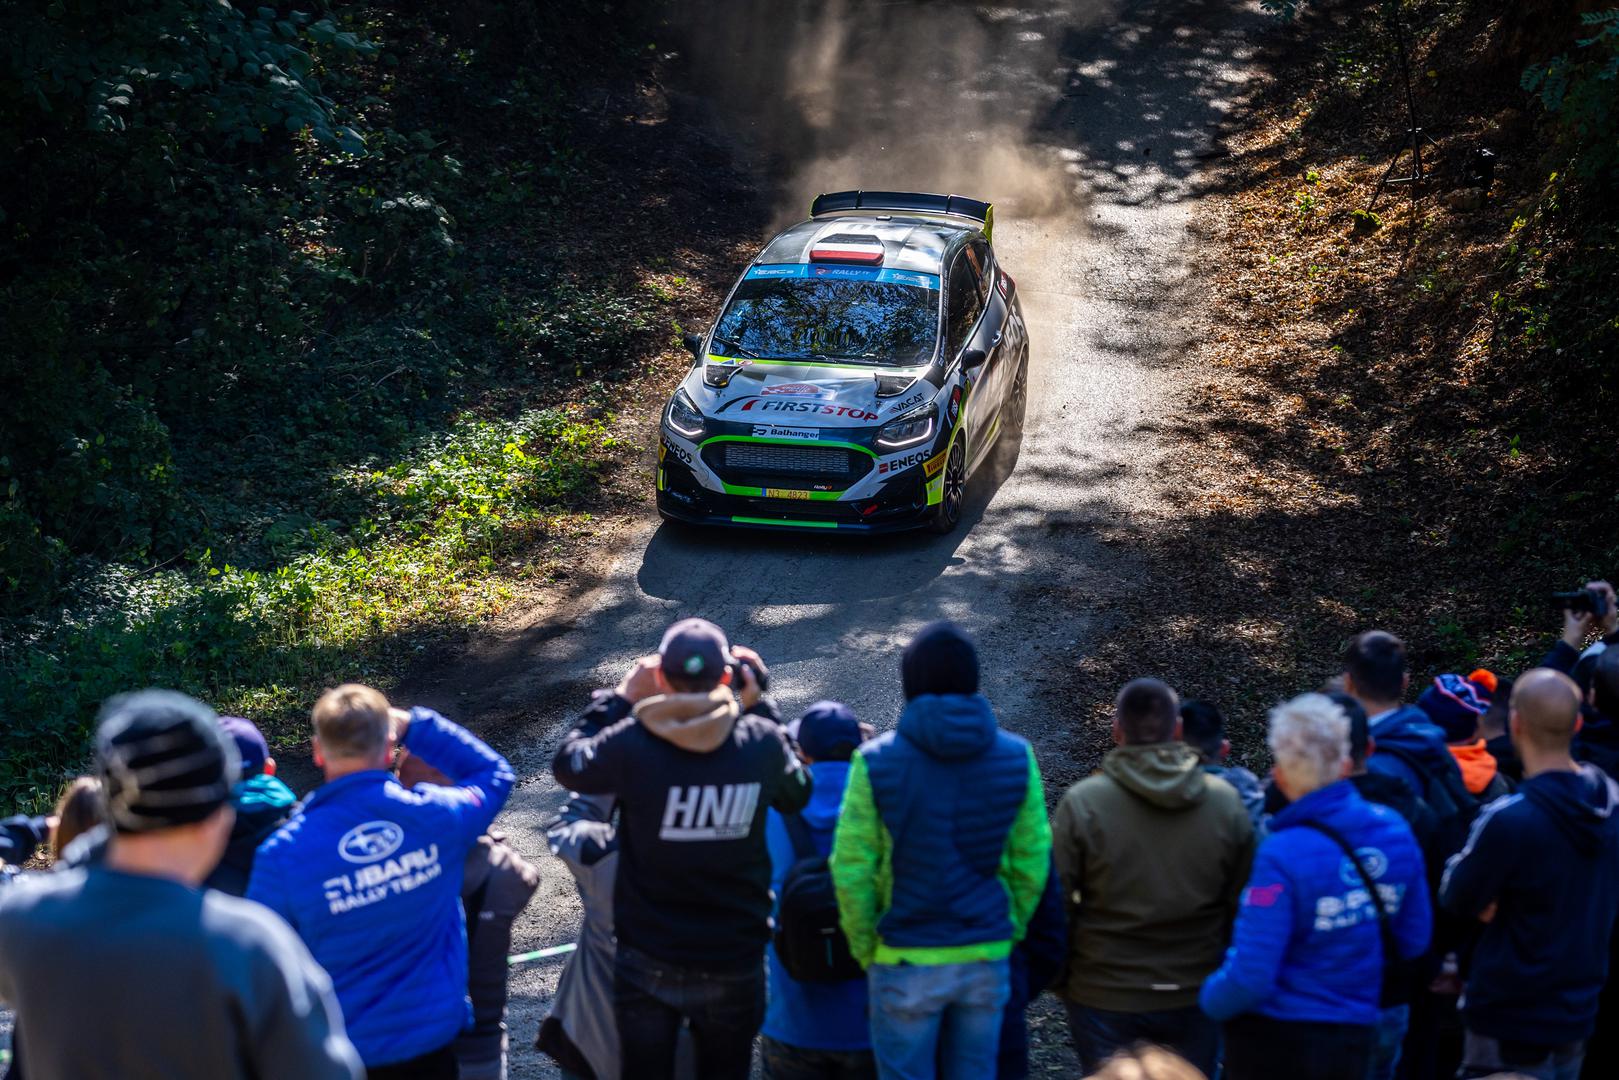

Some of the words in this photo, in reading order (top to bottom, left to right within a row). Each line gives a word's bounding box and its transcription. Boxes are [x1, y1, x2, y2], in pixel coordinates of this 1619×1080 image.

[761, 399, 879, 422] FIRSTSTOP
[893, 392, 925, 412] VACAT
[770, 428, 820, 439] Balhanger
[889, 449, 930, 472] ENEOS
